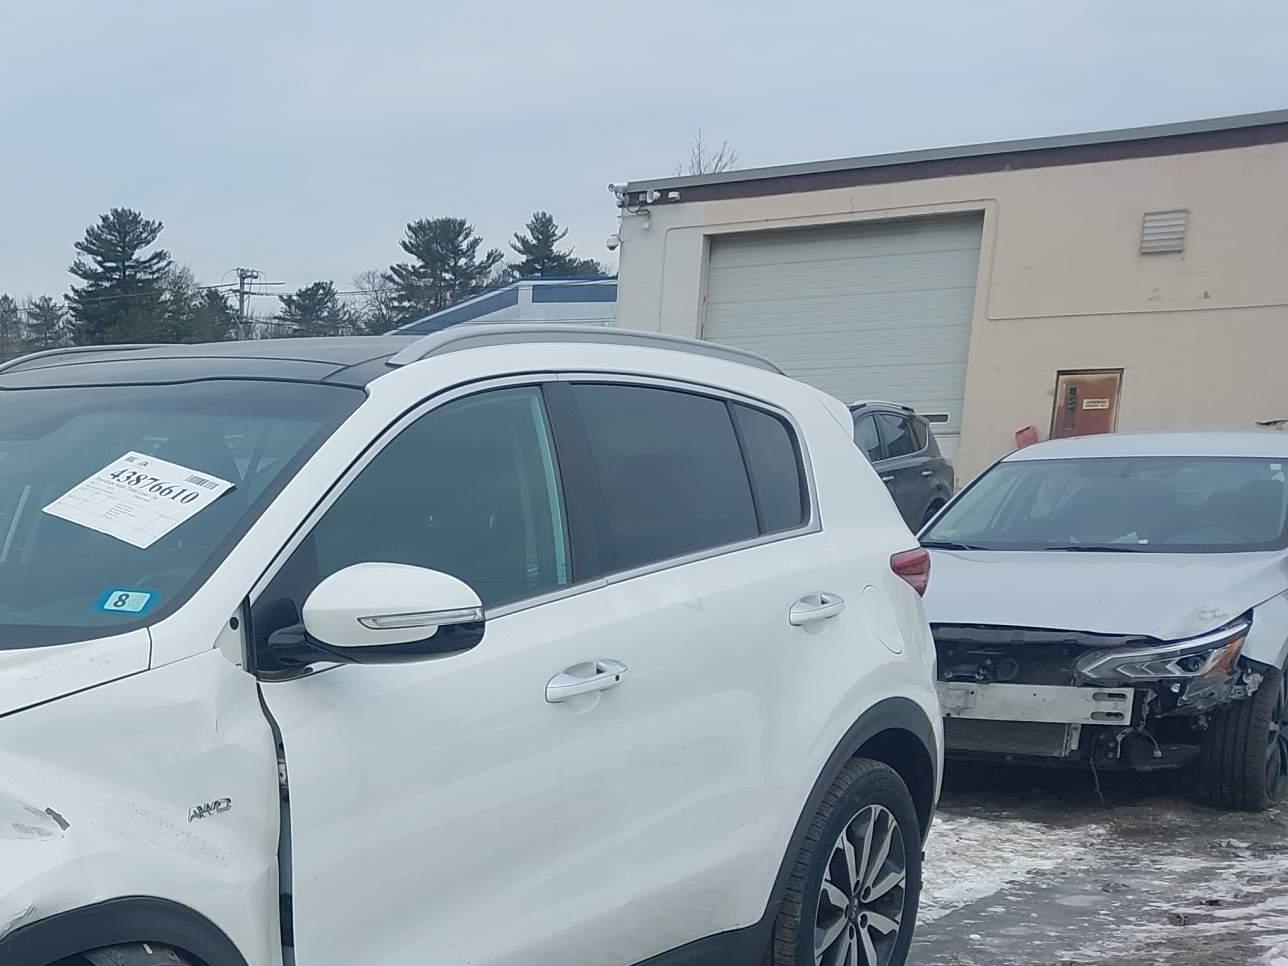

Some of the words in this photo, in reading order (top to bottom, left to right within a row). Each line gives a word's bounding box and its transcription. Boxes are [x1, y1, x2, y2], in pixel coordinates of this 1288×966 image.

[109, 468, 200, 504] 43876610
[113, 593, 130, 608] 8
[187, 797, 232, 823] AWD
